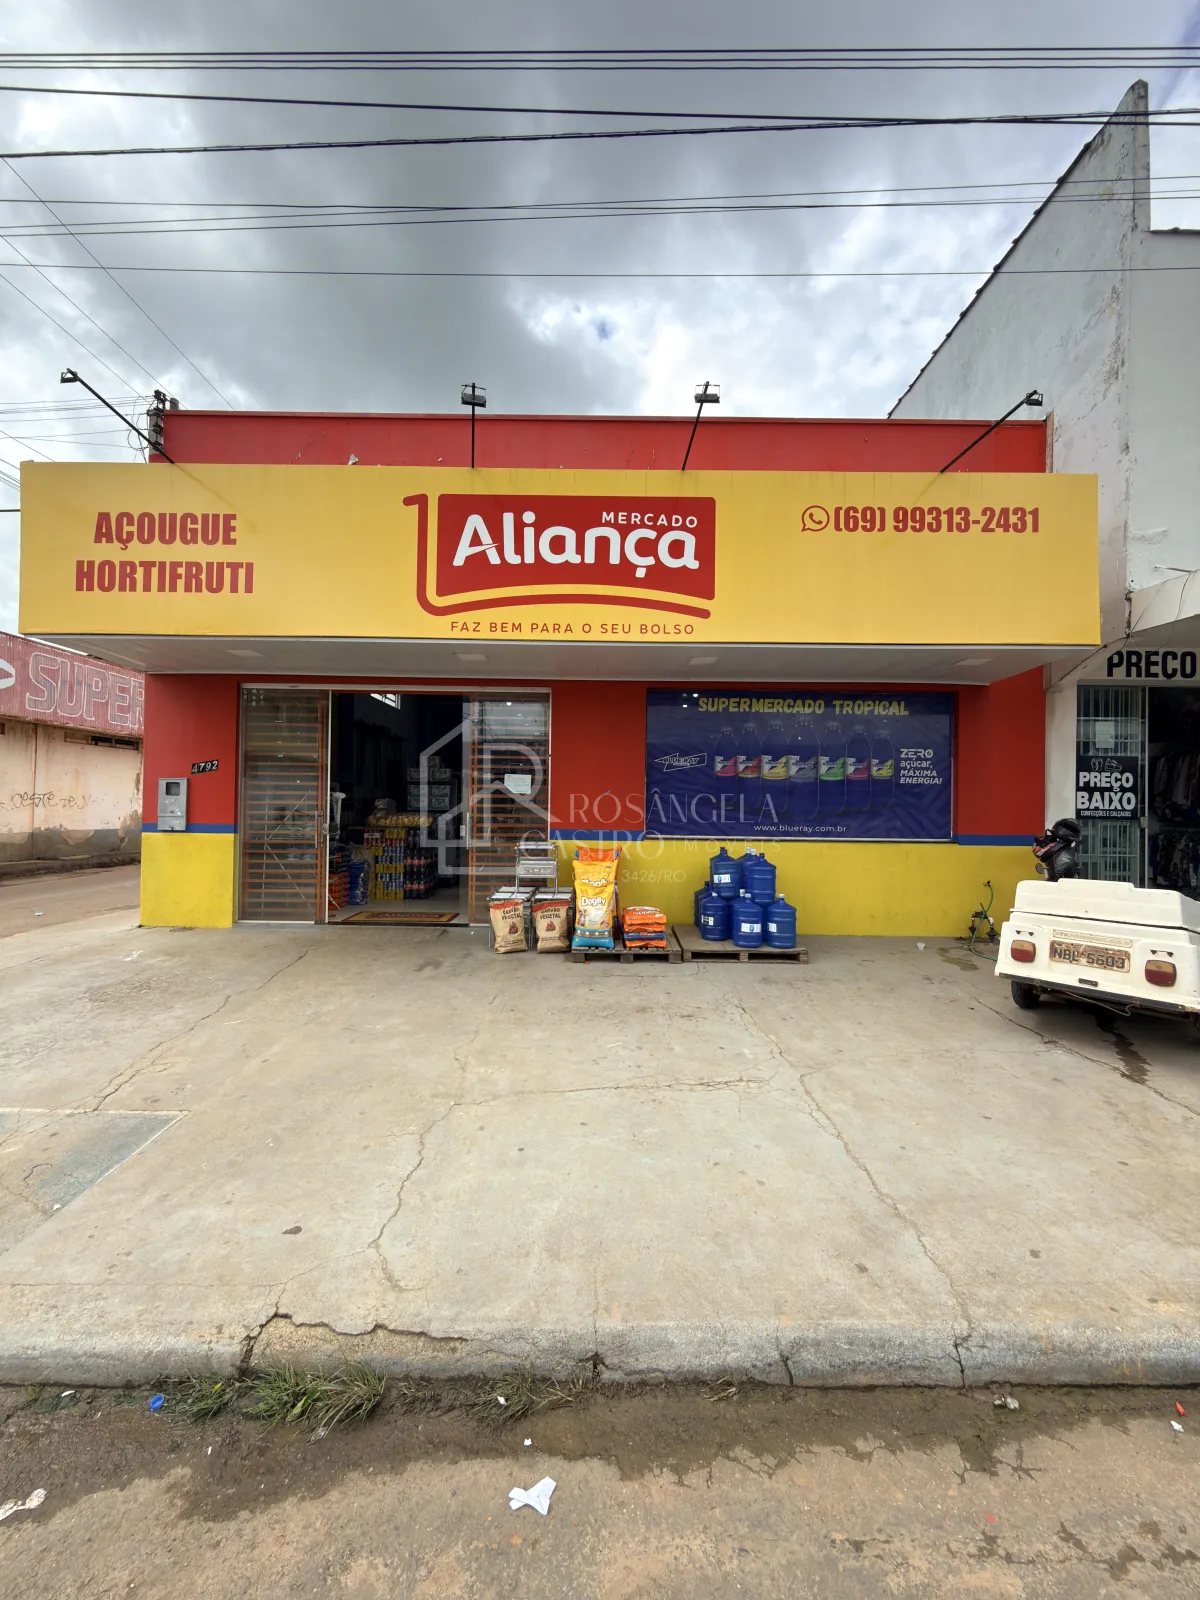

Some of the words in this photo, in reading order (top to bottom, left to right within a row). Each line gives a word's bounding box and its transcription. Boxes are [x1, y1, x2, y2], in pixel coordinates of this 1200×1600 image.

[601, 511, 699, 529] MERCADO
[834, 506, 887, 533] (69)
[892, 507, 1040, 533] 99313-2431
[93, 511, 237, 552] AÇOUGUE
[452, 510, 700, 578] Aliança
[75, 559, 254, 594] HORTIFRUTI
[450, 621, 481, 633] FAZ
[489, 622, 523, 634] BEM
[530, 623, 574, 635] PARA
[581, 624, 593, 635] O
[599, 624, 632, 636] SEU
[639, 624, 695, 636] BOLSO
[698, 697, 825, 715] SUPERMERCADO
[832, 699, 909, 717] TROPICAL
[191, 760, 219, 774] 4792
[900, 757, 933, 769] açúcar,
[899, 768, 938, 777] MÁXIMA
[899, 777, 943, 785] ENERGIA!
[1078, 771, 1134, 792] PREÇO
[1076, 791, 1136, 811] BAIXO
[753, 824, 847, 835] www.blueray.com.br
[1086, 953, 1125, 969] 5603
